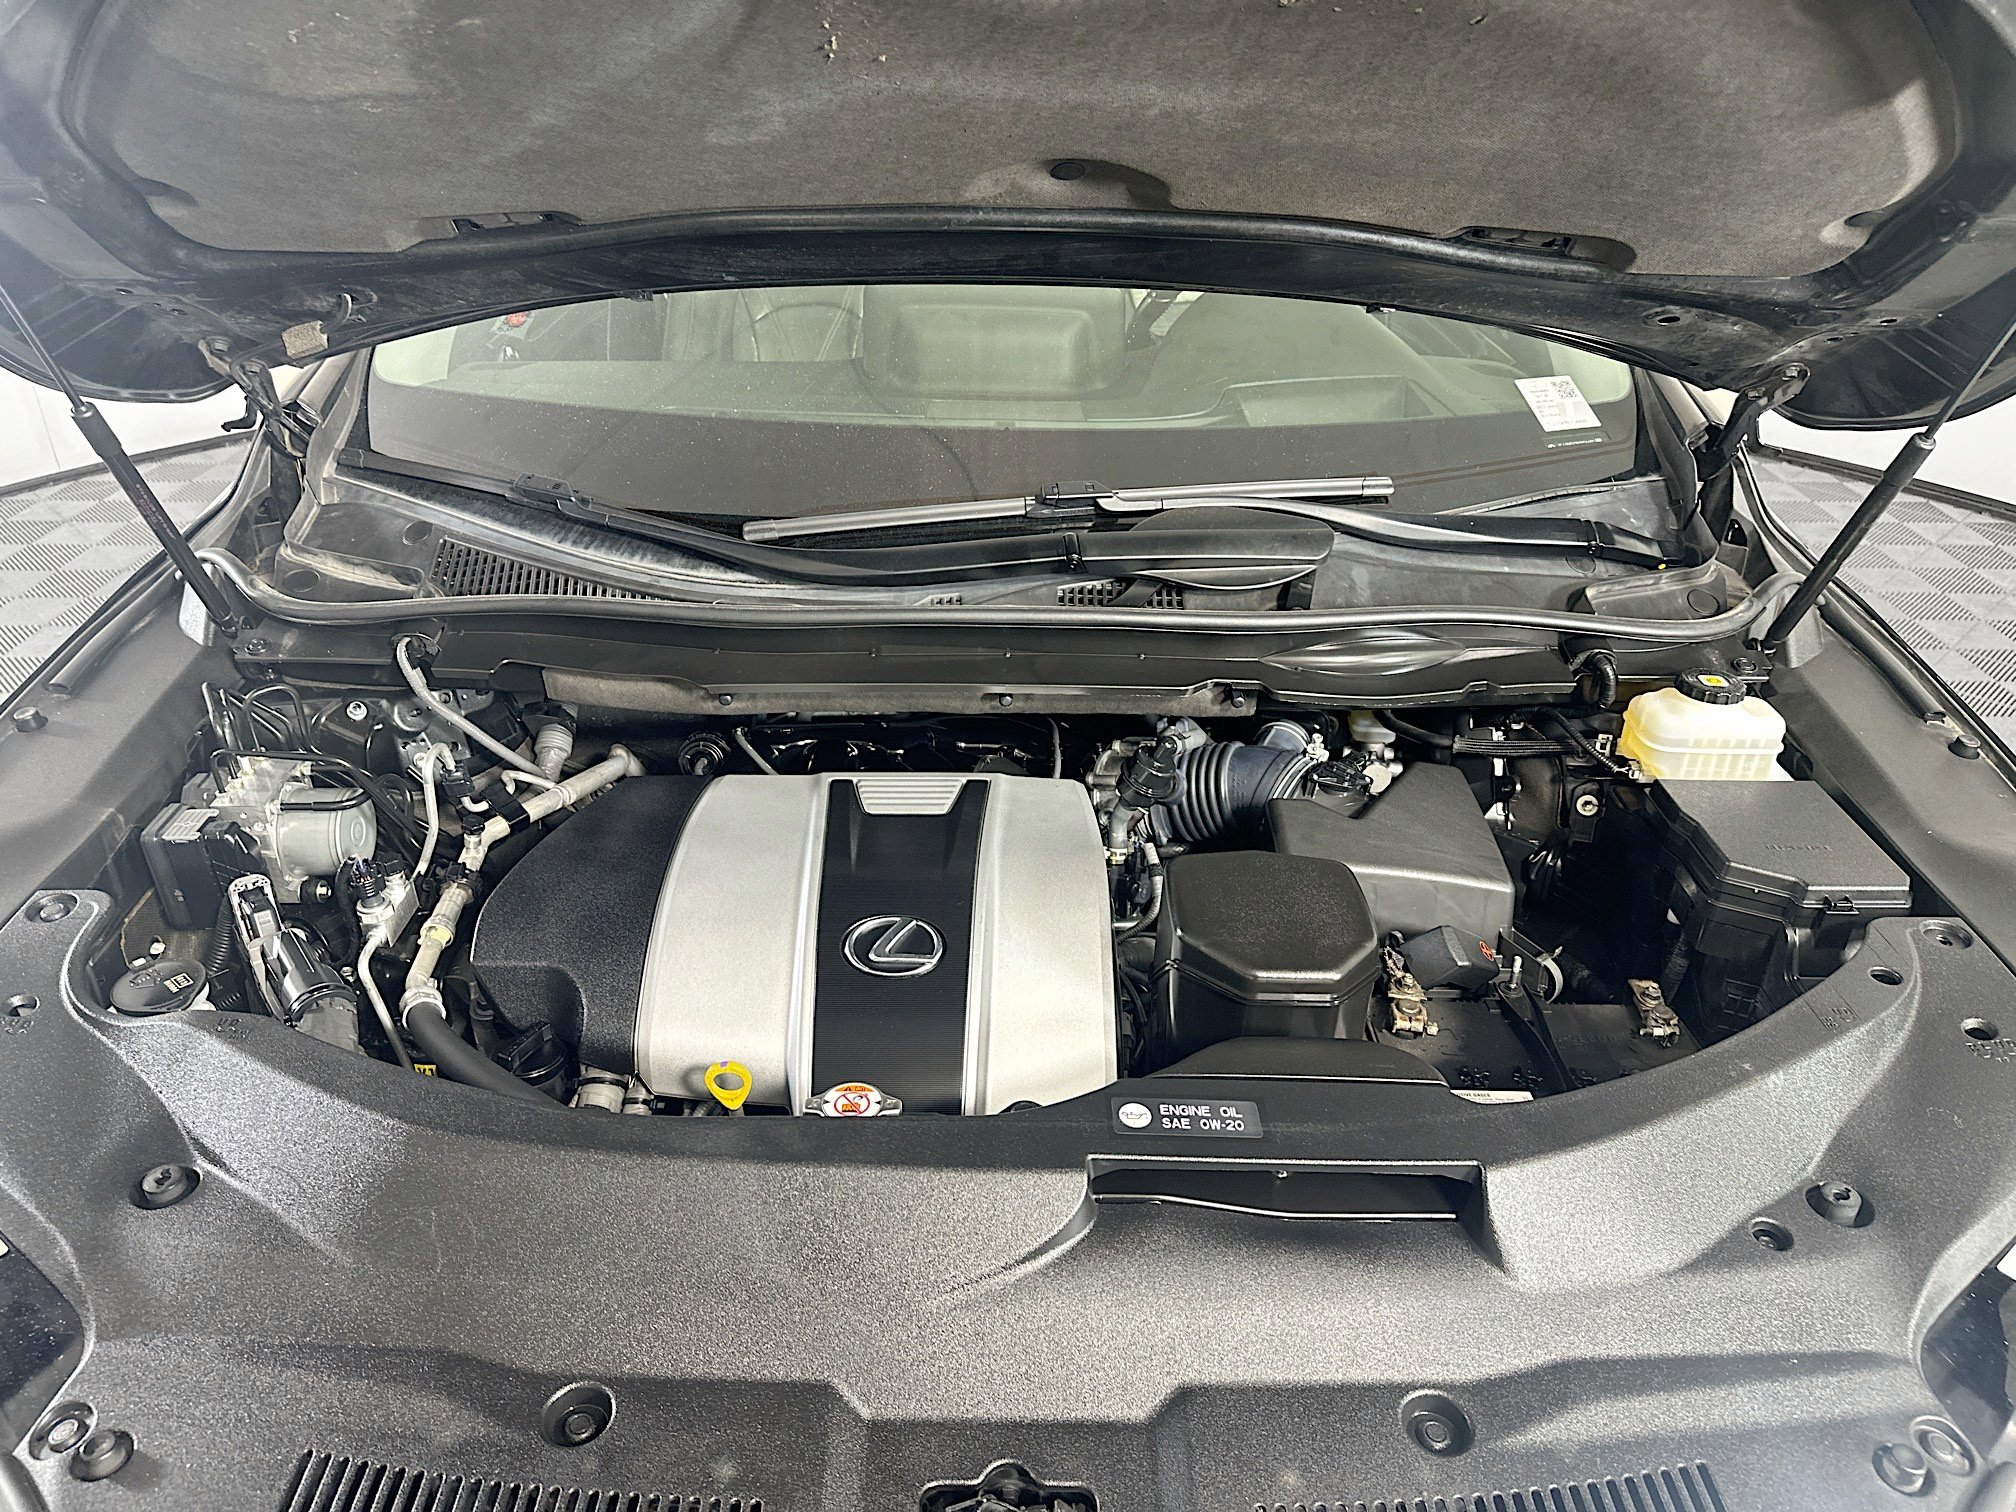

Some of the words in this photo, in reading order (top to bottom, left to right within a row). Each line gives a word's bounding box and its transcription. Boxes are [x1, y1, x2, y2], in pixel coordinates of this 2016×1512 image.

[1159, 1104, 1211, 1117] ENGINE
[1219, 1106, 1243, 1118] OIL
[1161, 1117, 1192, 1130] SAE
[1200, 1119, 1245, 1131] 0W-20
